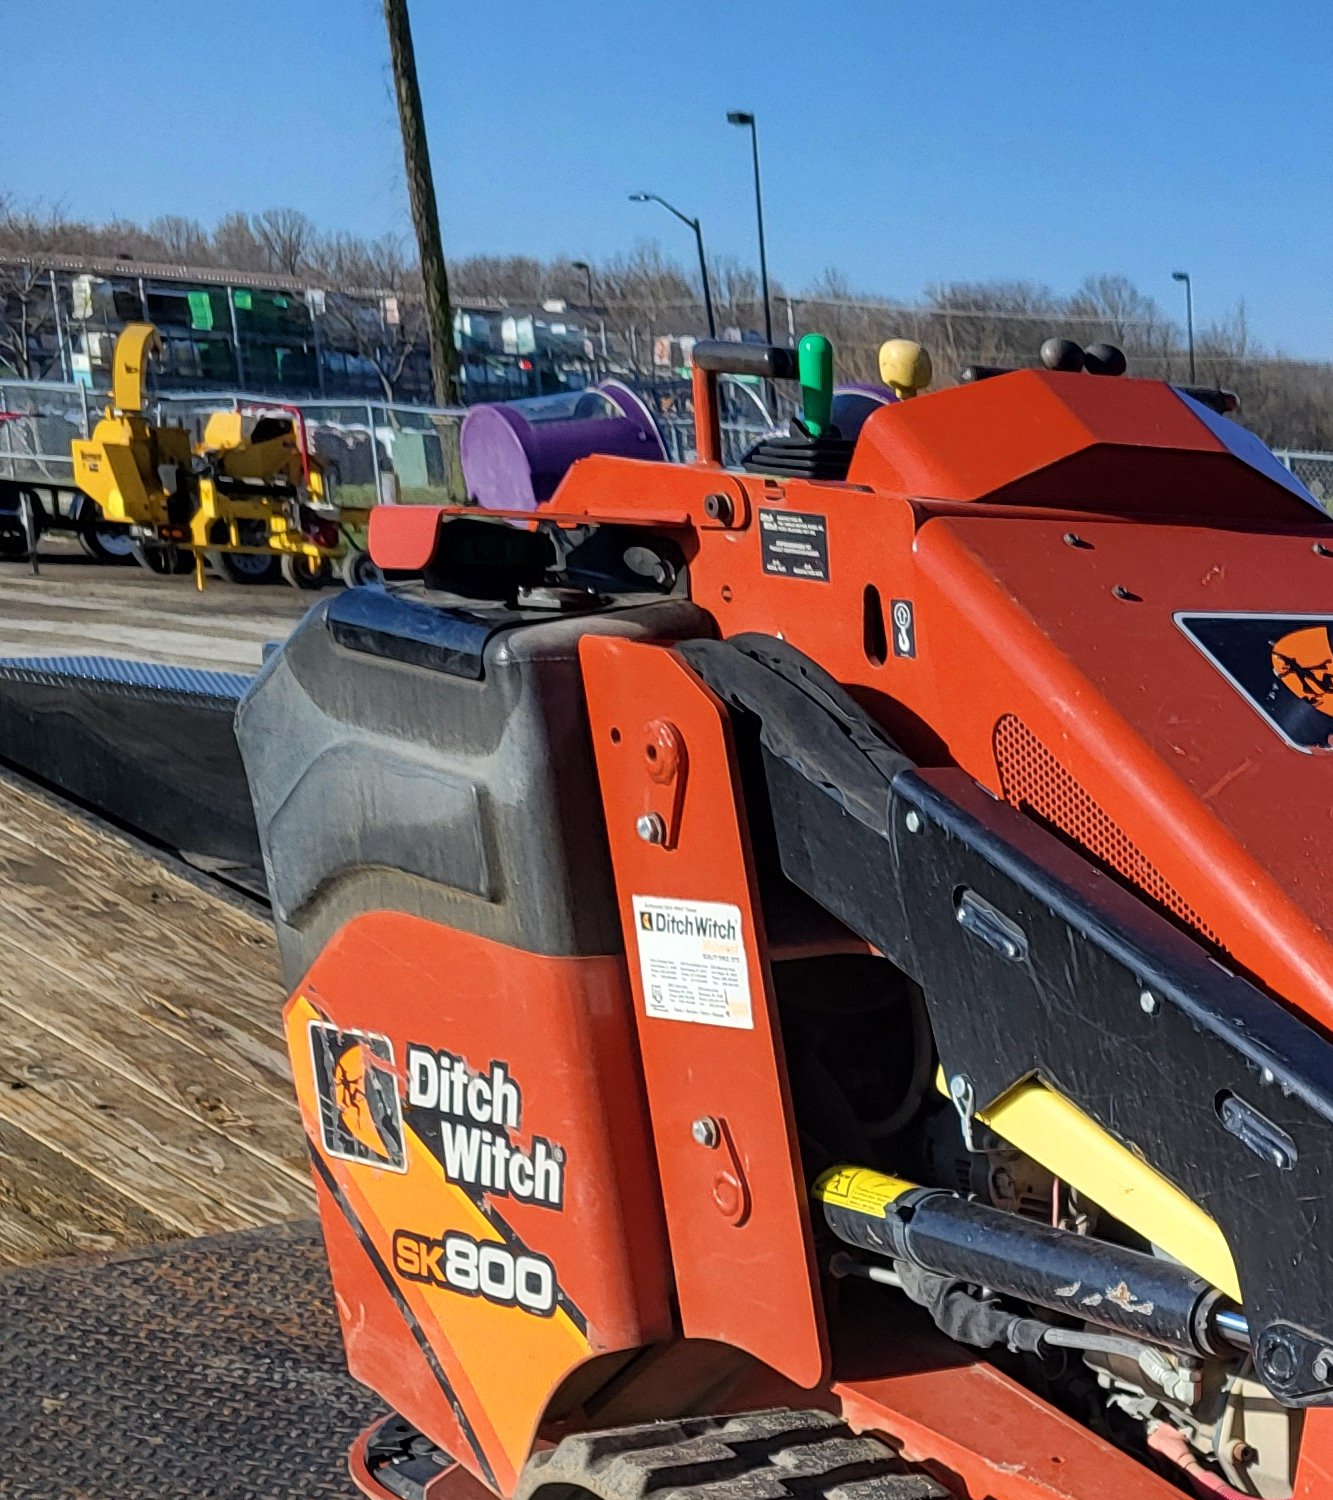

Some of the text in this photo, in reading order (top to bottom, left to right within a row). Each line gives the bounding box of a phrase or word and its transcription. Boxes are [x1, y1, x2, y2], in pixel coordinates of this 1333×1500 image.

[409, 1049, 519, 1128] Ditch
[440, 1120, 560, 1204] Witch
[396, 1236, 553, 1311] SK800
